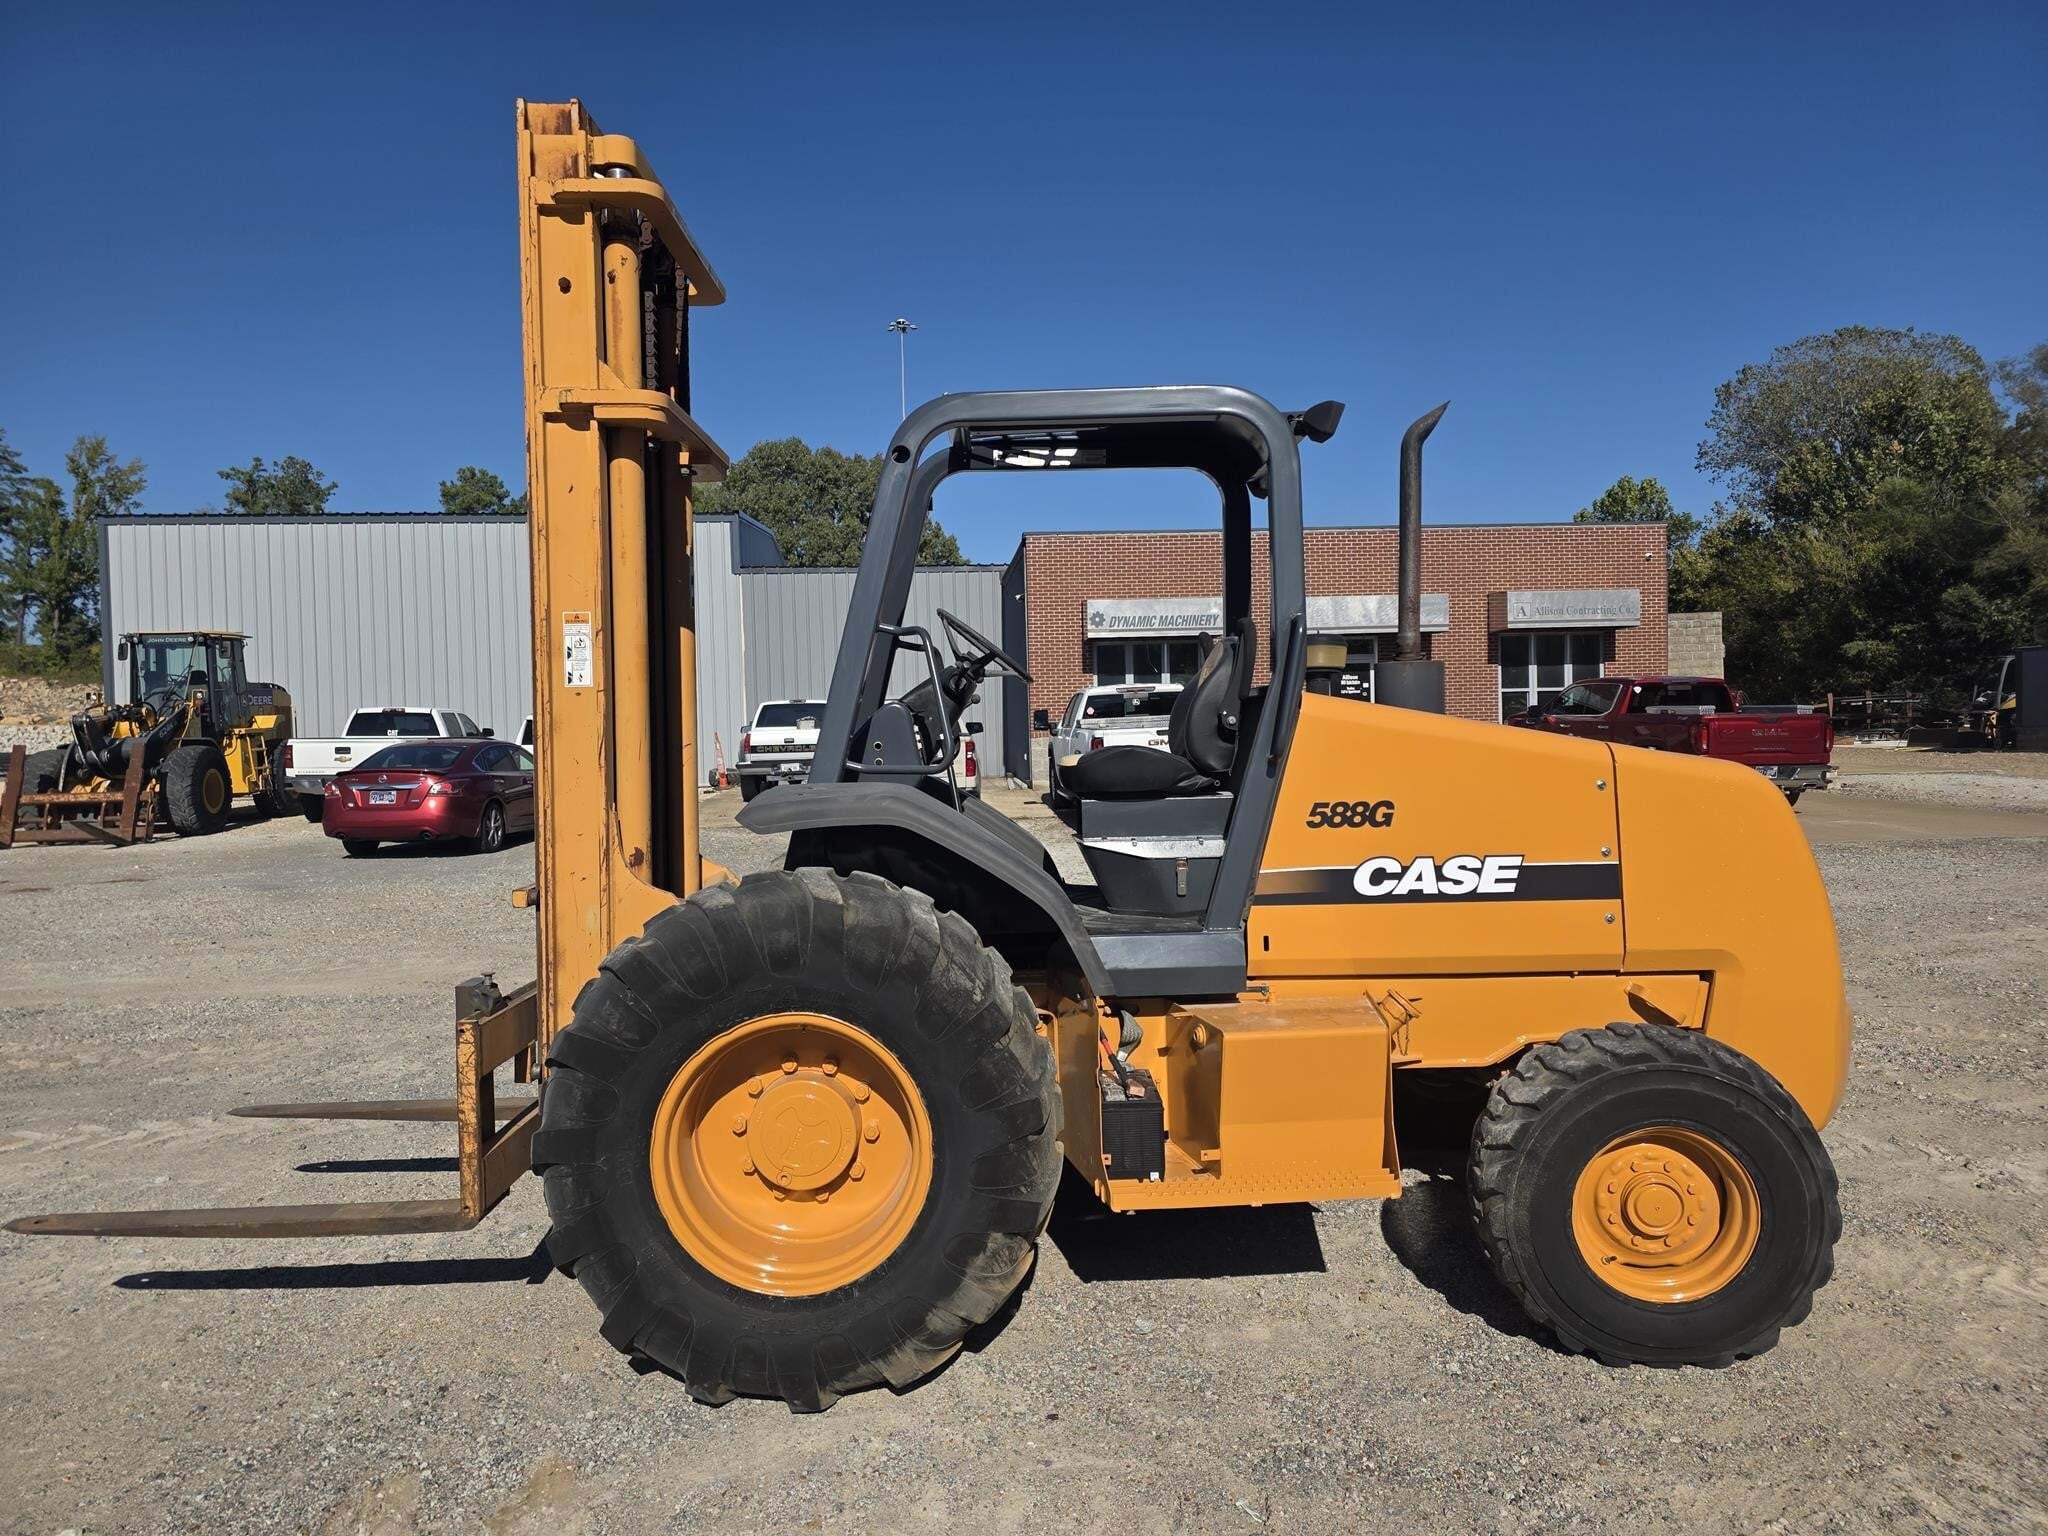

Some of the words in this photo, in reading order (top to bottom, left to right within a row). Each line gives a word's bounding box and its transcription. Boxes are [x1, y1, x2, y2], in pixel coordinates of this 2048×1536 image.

[1535, 606, 1564, 616] Allison
[1566, 605, 1617, 617] Contracting
[1619, 605, 1634, 615] Co.
[1108, 615, 1156, 628] DYNAMIC
[1158, 614, 1220, 628] MACHINERY
[249, 695, 273, 705] DEERE
[387, 729, 399, 737] CAT
[756, 744, 817, 753] CHEVROLE
[1147, 739, 1169, 747] GM
[1306, 800, 1395, 828] 588G
[1353, 855, 1526, 897] CASE
